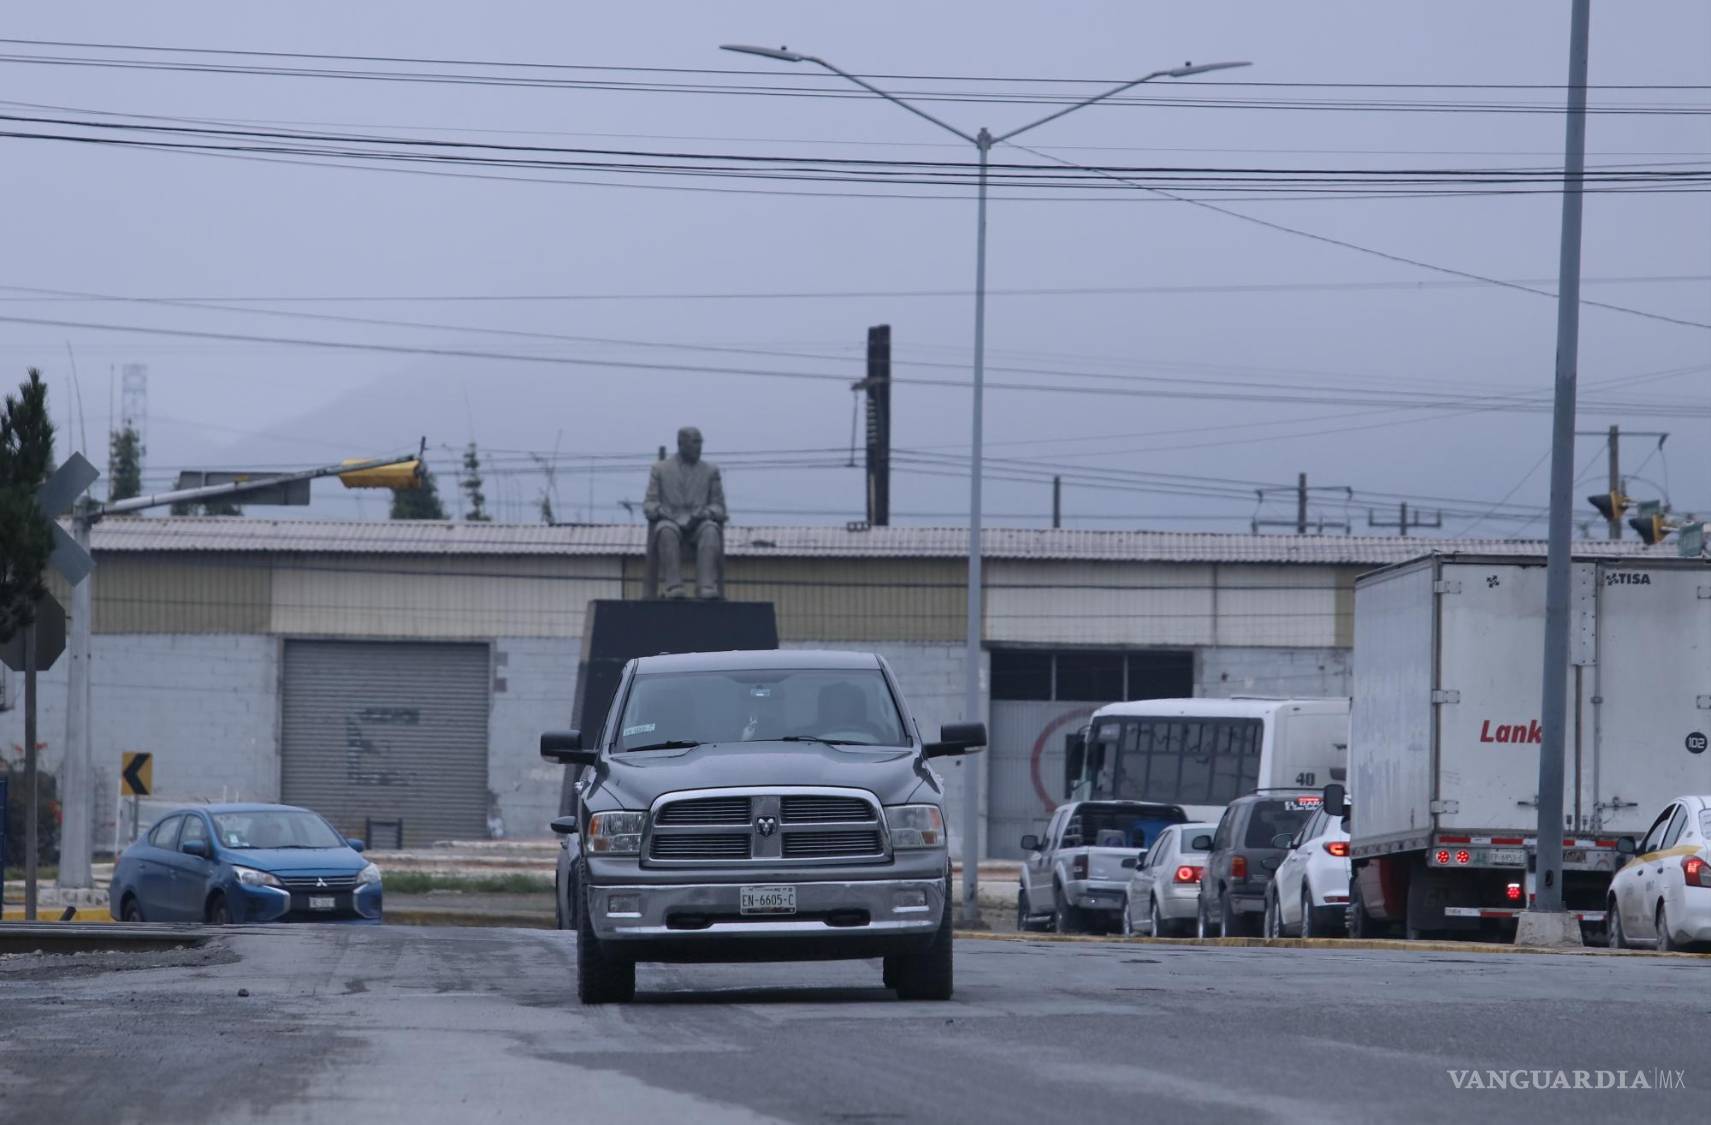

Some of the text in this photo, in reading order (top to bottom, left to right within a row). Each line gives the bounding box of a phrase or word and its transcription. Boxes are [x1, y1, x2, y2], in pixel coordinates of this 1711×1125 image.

[1618, 573, 1651, 585] TISA
[1688, 736, 1705, 749] 102
[1295, 772, 1315, 786] 40
[742, 894, 794, 906] EN-6605-C
